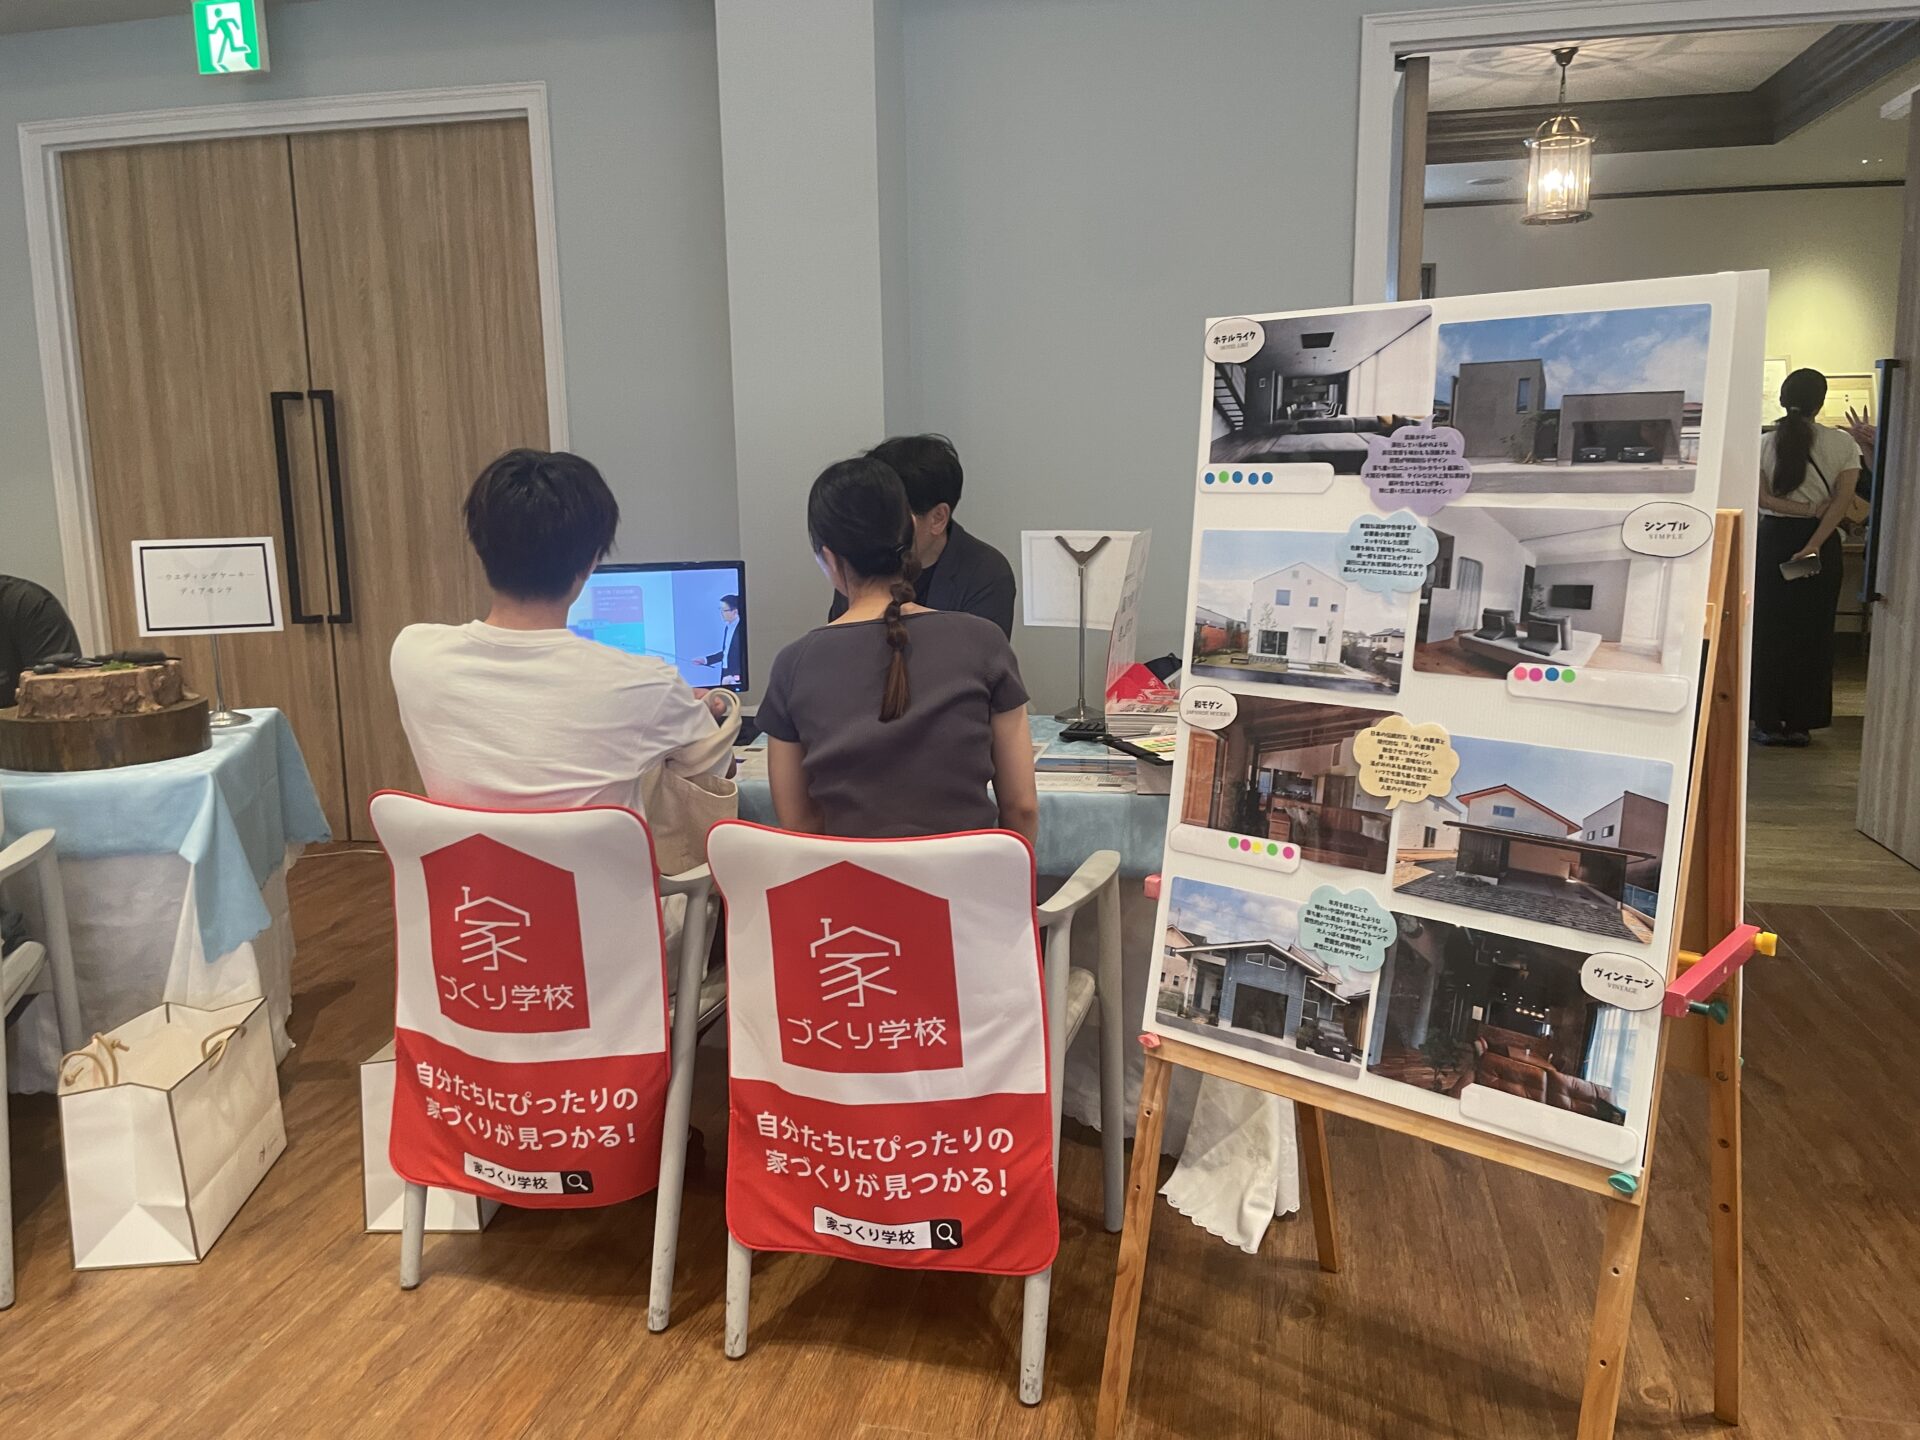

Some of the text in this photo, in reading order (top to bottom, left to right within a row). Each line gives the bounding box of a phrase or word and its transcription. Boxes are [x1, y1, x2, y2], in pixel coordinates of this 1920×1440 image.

[1212, 331, 1256, 345] ホテルライク
[1644, 521, 1690, 531] シンプル
[1194, 700, 1223, 709] 和モダン
[454, 886, 531, 971] 家
[810, 918, 900, 1007] 家
[1593, 967, 1654, 988] ヴィンテージ
[440, 974, 575, 1012] づくり学校
[1607, 982, 1638, 994] VINTAGE
[787, 1016, 948, 1049] づくり学校
[416, 1062, 638, 1116] 自分たちにぴったりの
[426, 1096, 637, 1151] 家づくりが見つかる!
[757, 1111, 1014, 1162] 自分たちにぴったりの
[473, 1161, 549, 1190] 家づくり学校
[765, 1150, 1008, 1200] 家づくりが見つかる!
[825, 1216, 916, 1245] 家づくり学校
